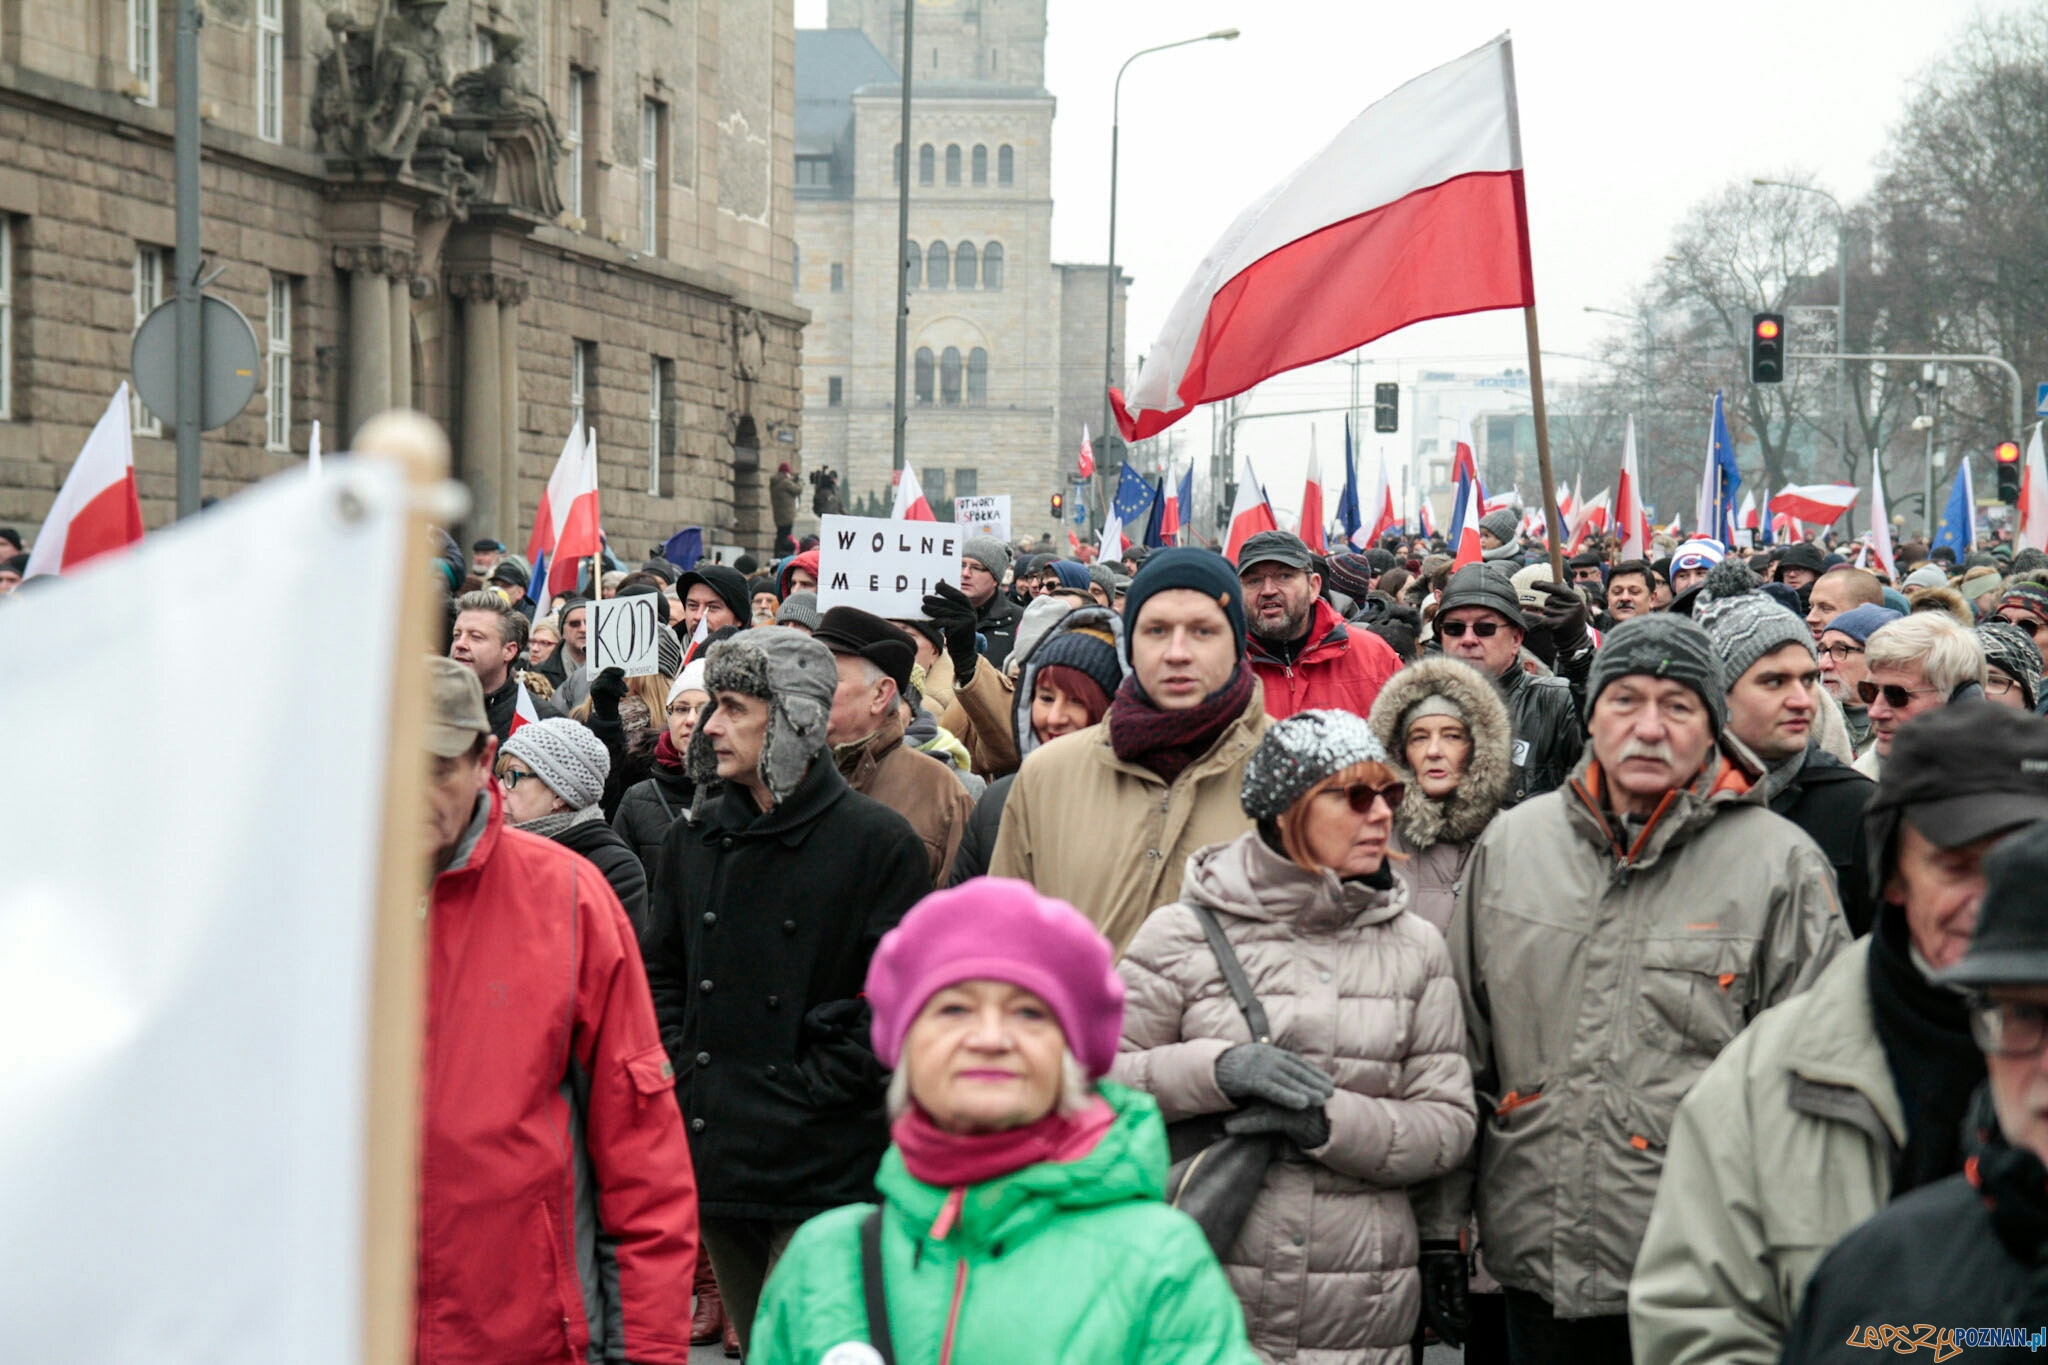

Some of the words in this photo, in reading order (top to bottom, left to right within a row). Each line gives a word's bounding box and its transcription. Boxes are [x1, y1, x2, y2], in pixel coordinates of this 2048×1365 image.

[837, 530, 955, 556] WOLNE
[830, 571, 946, 596] MEDI
[594, 599, 656, 669] KOD
